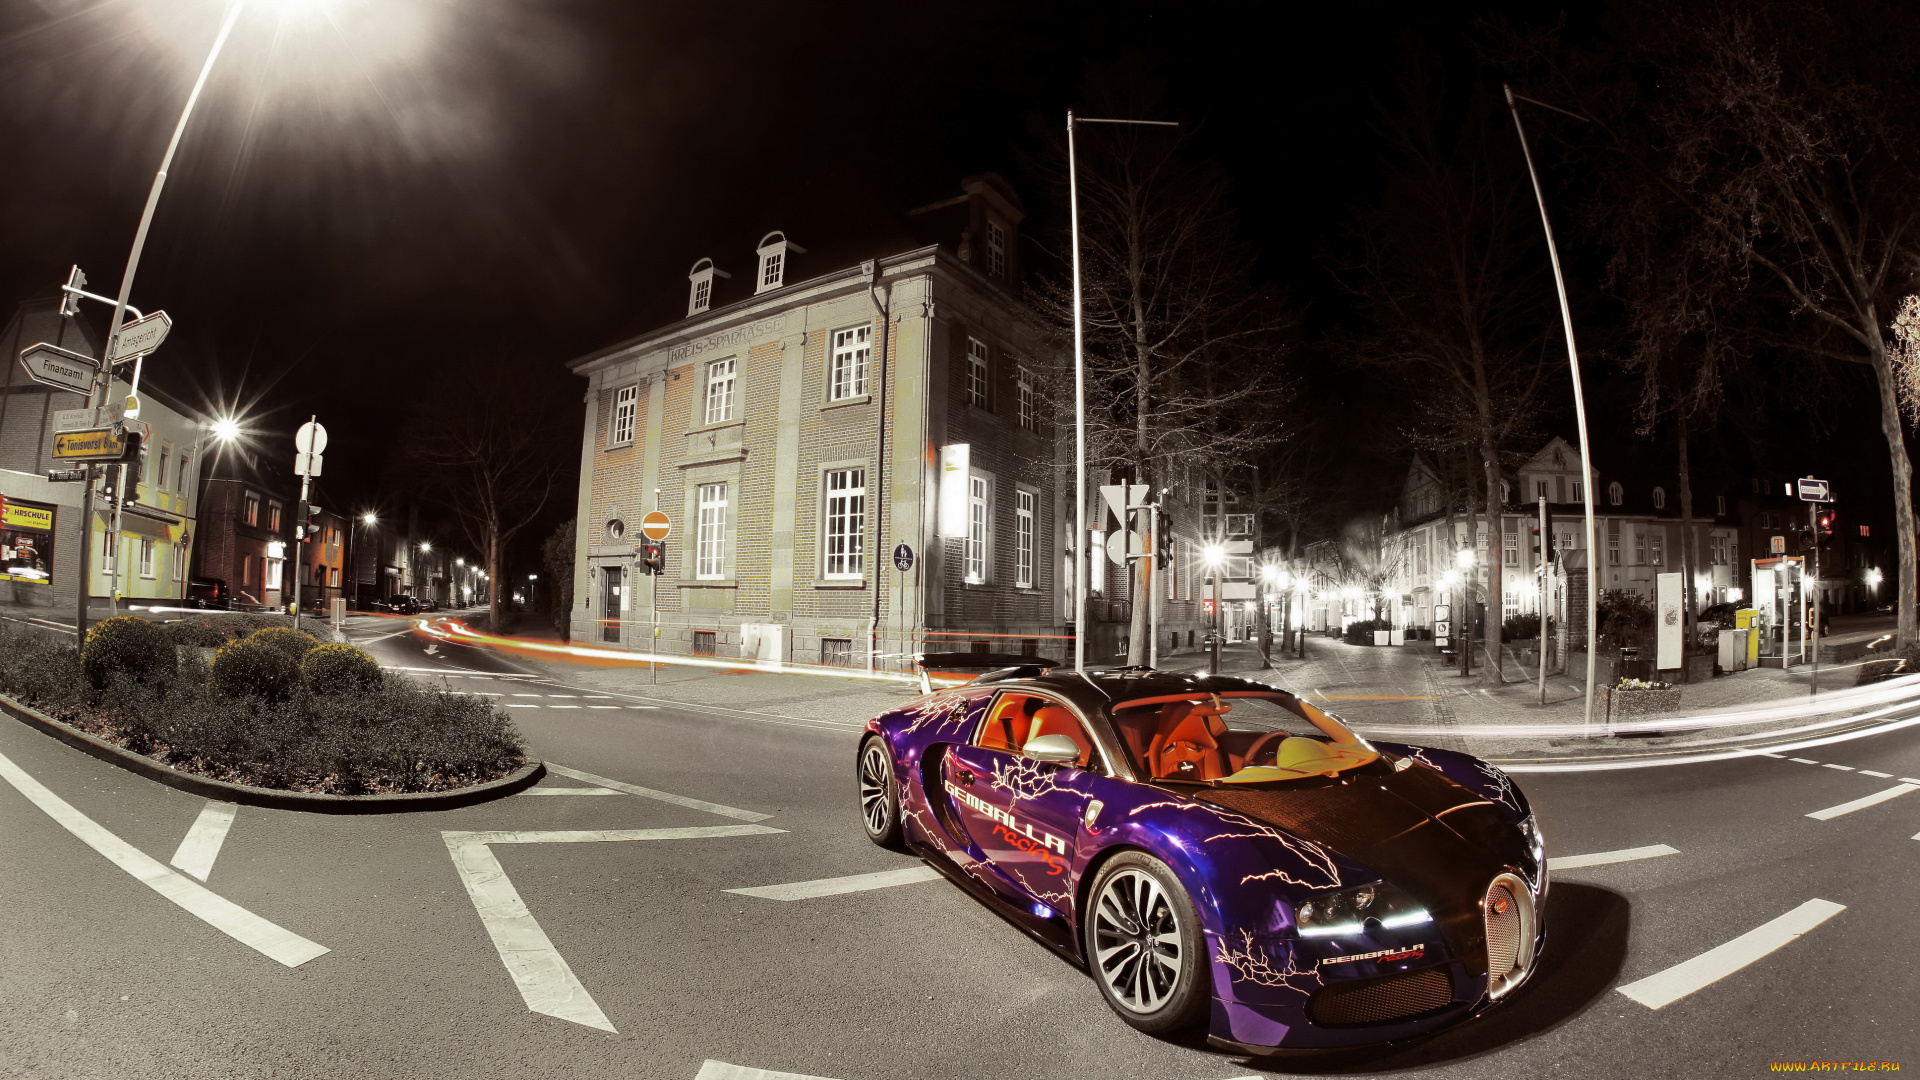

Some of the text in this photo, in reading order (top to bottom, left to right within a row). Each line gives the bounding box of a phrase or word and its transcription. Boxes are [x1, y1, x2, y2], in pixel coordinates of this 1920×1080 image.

[121, 327, 157, 350] Amtsgericht
[671, 319, 783, 362] KREIS-SPARKASSE
[42, 359, 84, 381] Finanzamt
[67, 438, 101, 451] Tönisvorst
[6, 507, 50, 520] HRSCHULE
[1773, 538, 1783, 553] T
[944, 779, 1065, 856] GEMBALLA
[992, 824, 1065, 876] racing
[1322, 943, 1425, 965] GEMBALLA
[1377, 949, 1425, 964] racing
